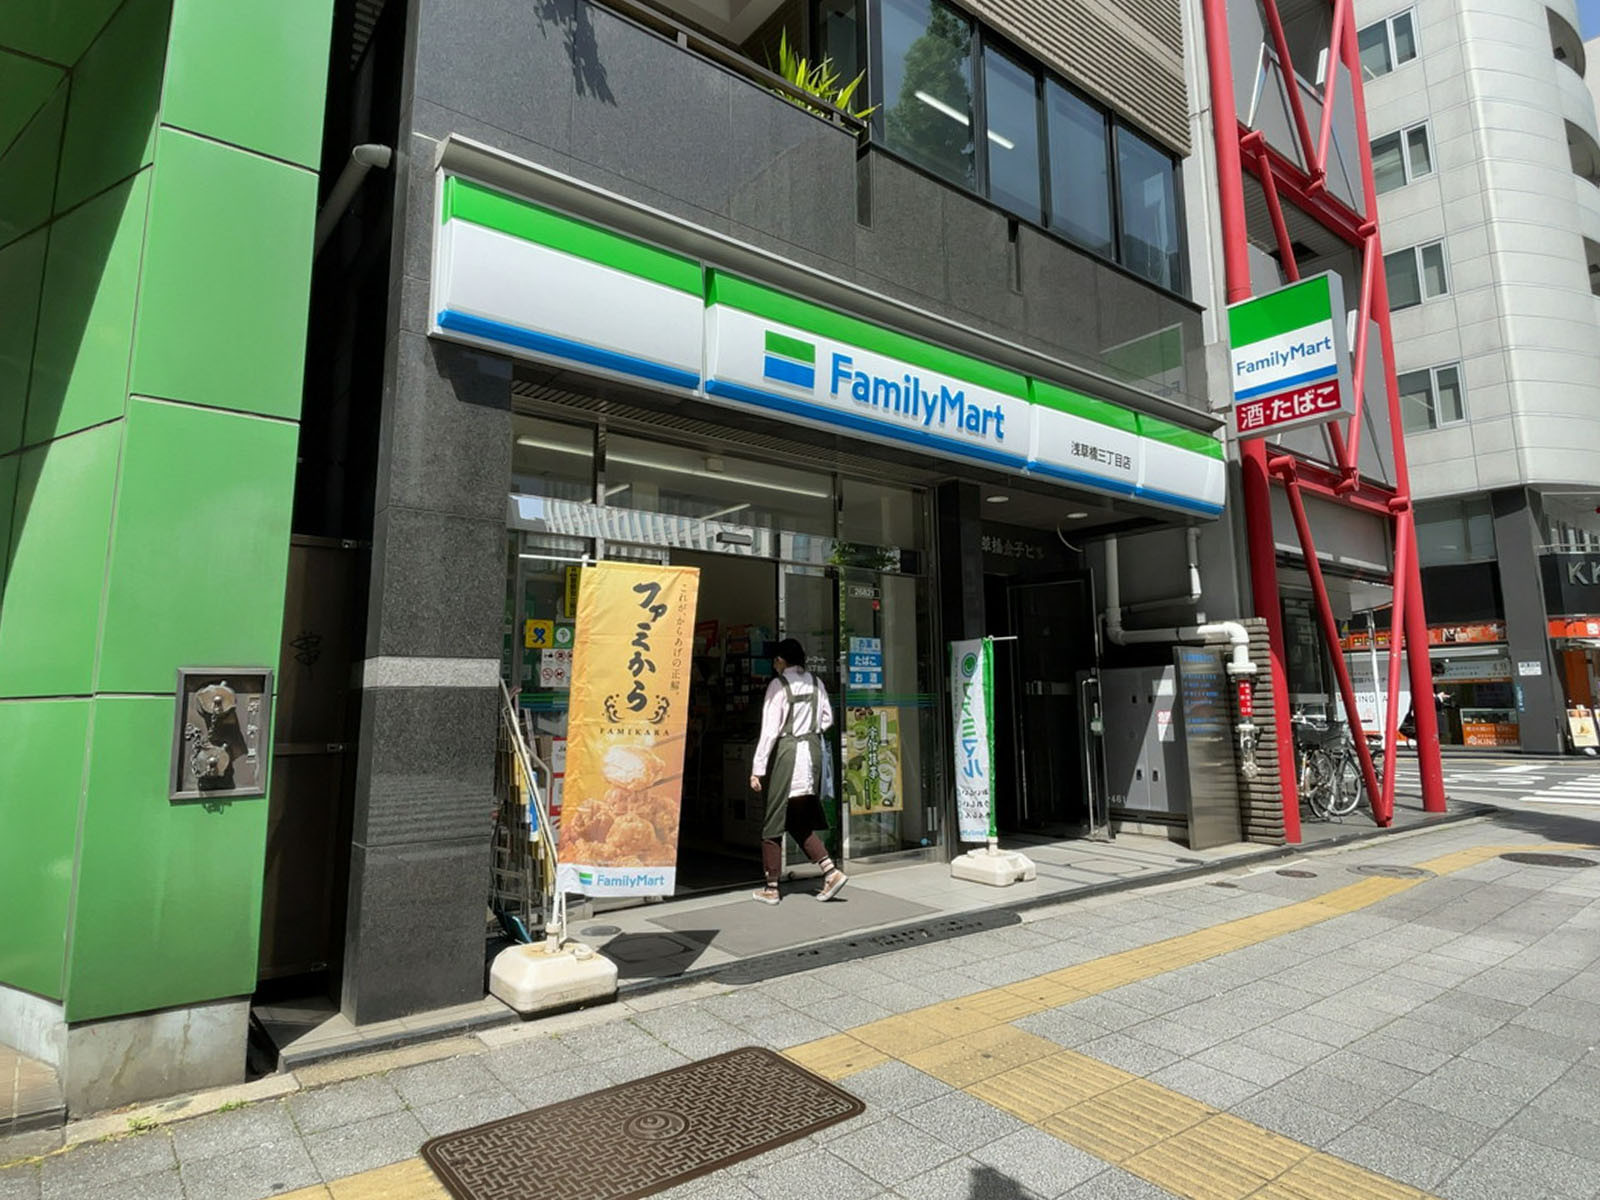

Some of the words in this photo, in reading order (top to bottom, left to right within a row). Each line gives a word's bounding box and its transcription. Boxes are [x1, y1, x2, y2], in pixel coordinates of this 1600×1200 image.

[1236, 336, 1332, 376] FamilyMart
[830, 352, 1006, 441] FamilyMart
[1070, 441, 1132, 470] 浅草橋三丁目店
[627, 580, 668, 713] ファミから
[854, 655, 878, 667] たばこ
[600, 727, 670, 737] FAMIKARA
[597, 874, 665, 888] FamilyMart
